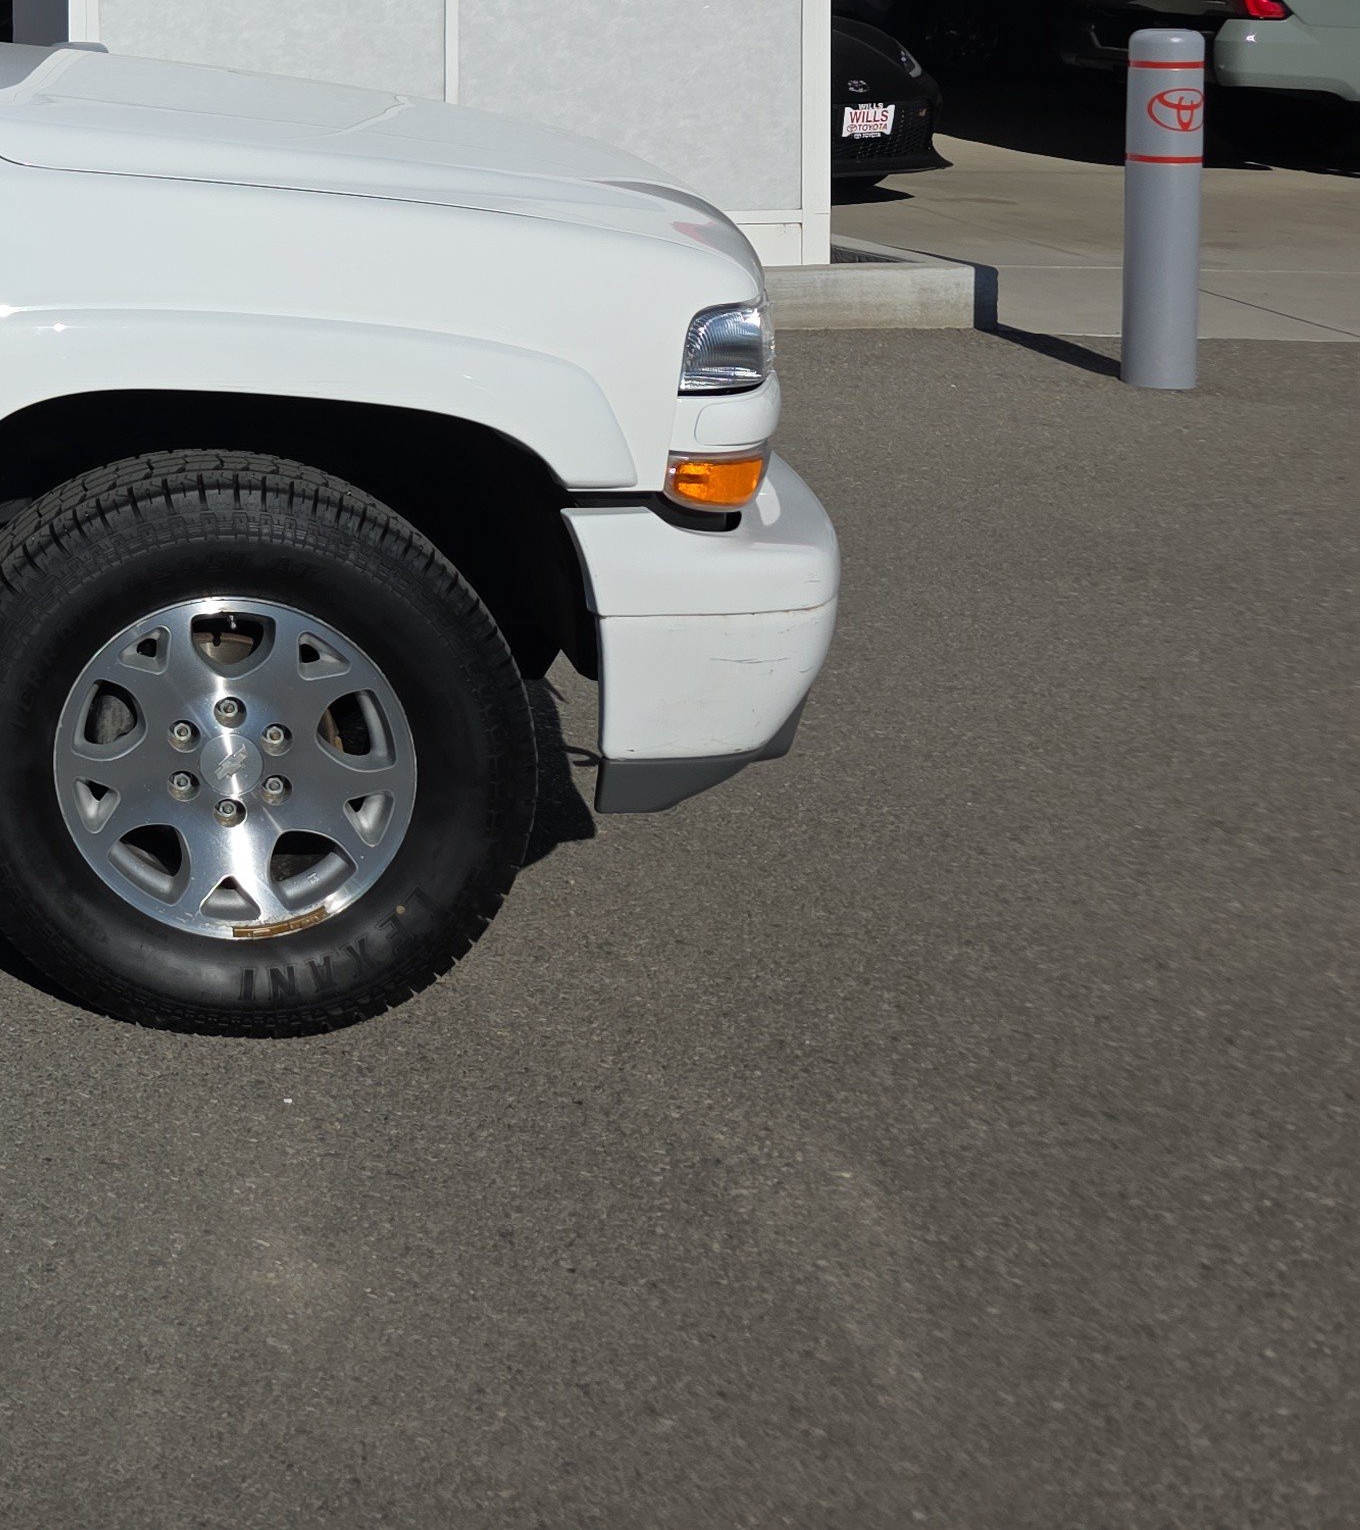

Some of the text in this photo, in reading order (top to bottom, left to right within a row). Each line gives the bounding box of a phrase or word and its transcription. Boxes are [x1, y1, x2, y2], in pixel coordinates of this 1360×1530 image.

[849, 110, 889, 123] WILLS
[858, 123, 888, 131] TOYOTA
[237, 885, 440, 1001] LEXANI
